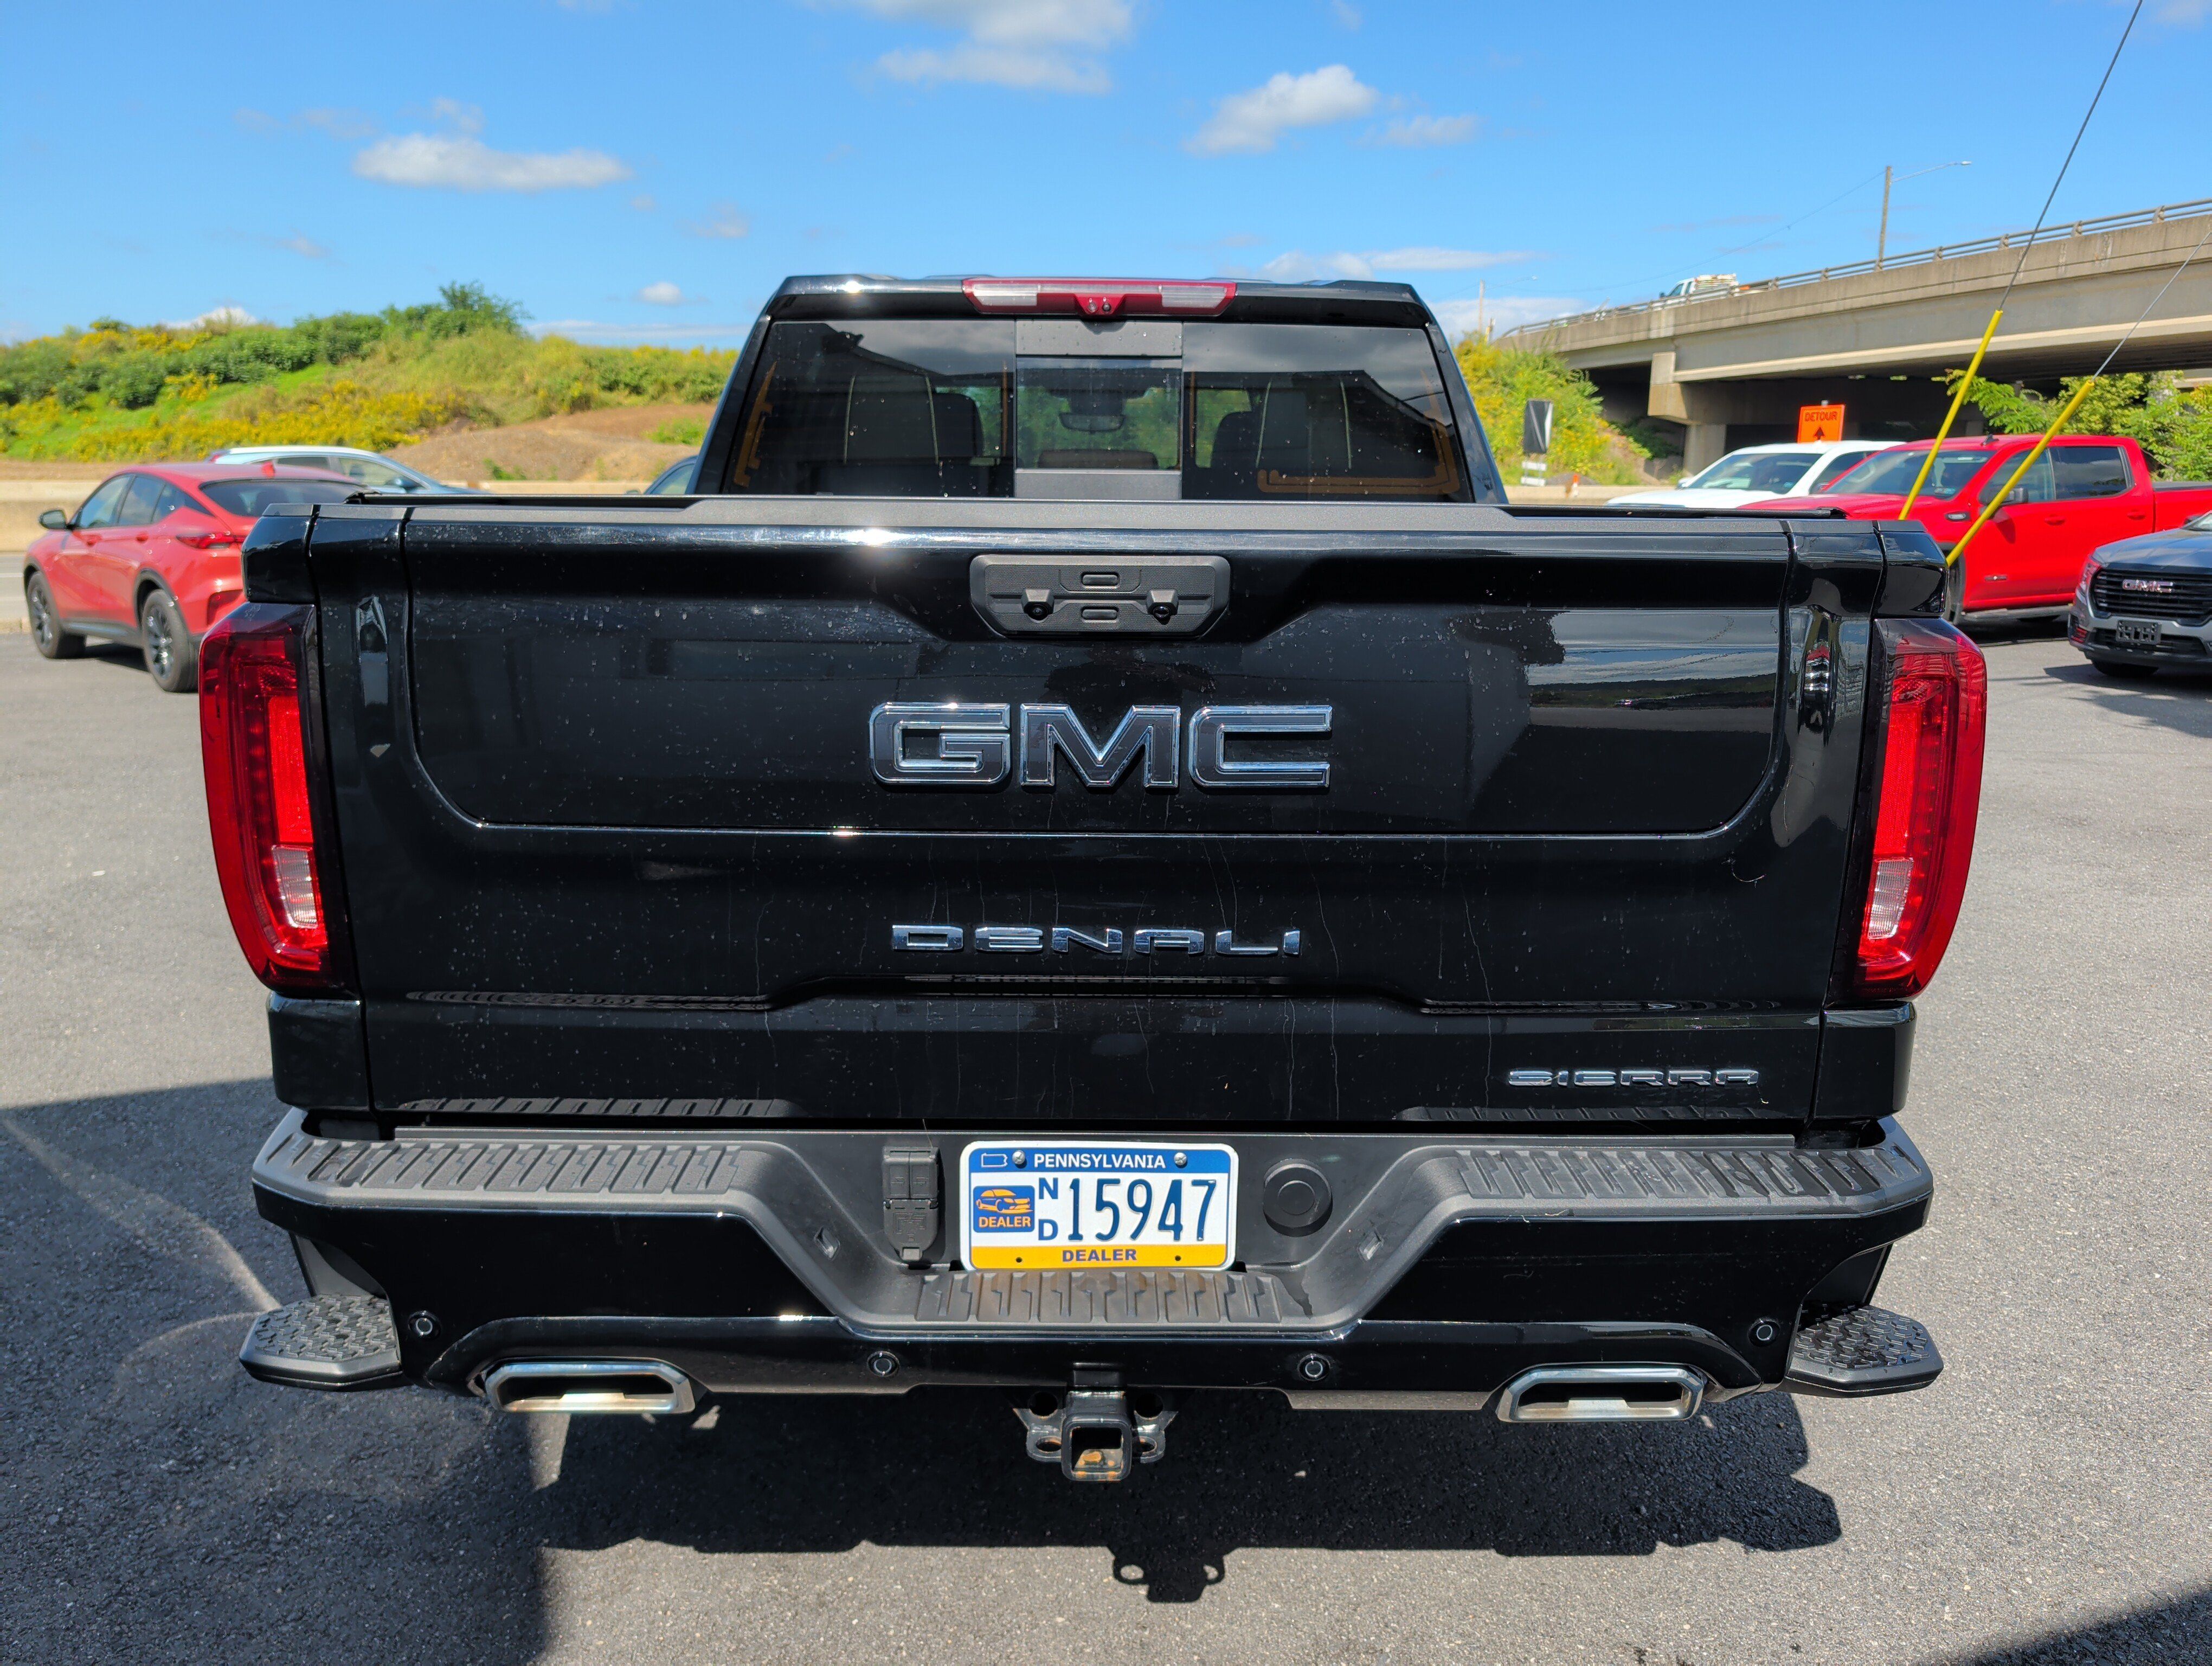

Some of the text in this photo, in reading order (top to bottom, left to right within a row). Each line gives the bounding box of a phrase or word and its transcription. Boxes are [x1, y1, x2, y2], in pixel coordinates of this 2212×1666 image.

[1804, 411, 1838, 422] DETOUR
[2122, 579, 2174, 593] GMC
[870, 702, 1333, 789] GMC
[892, 924, 1301, 956] DENALI
[1508, 1070, 1759, 1086] SIERRA
[1034, 1153, 1166, 1169] PENNSYLVANIA
[1068, 1177, 1217, 1241] 15947
[978, 1216, 1032, 1228] DEALER
[1062, 1248, 1137, 1263] DEALER
